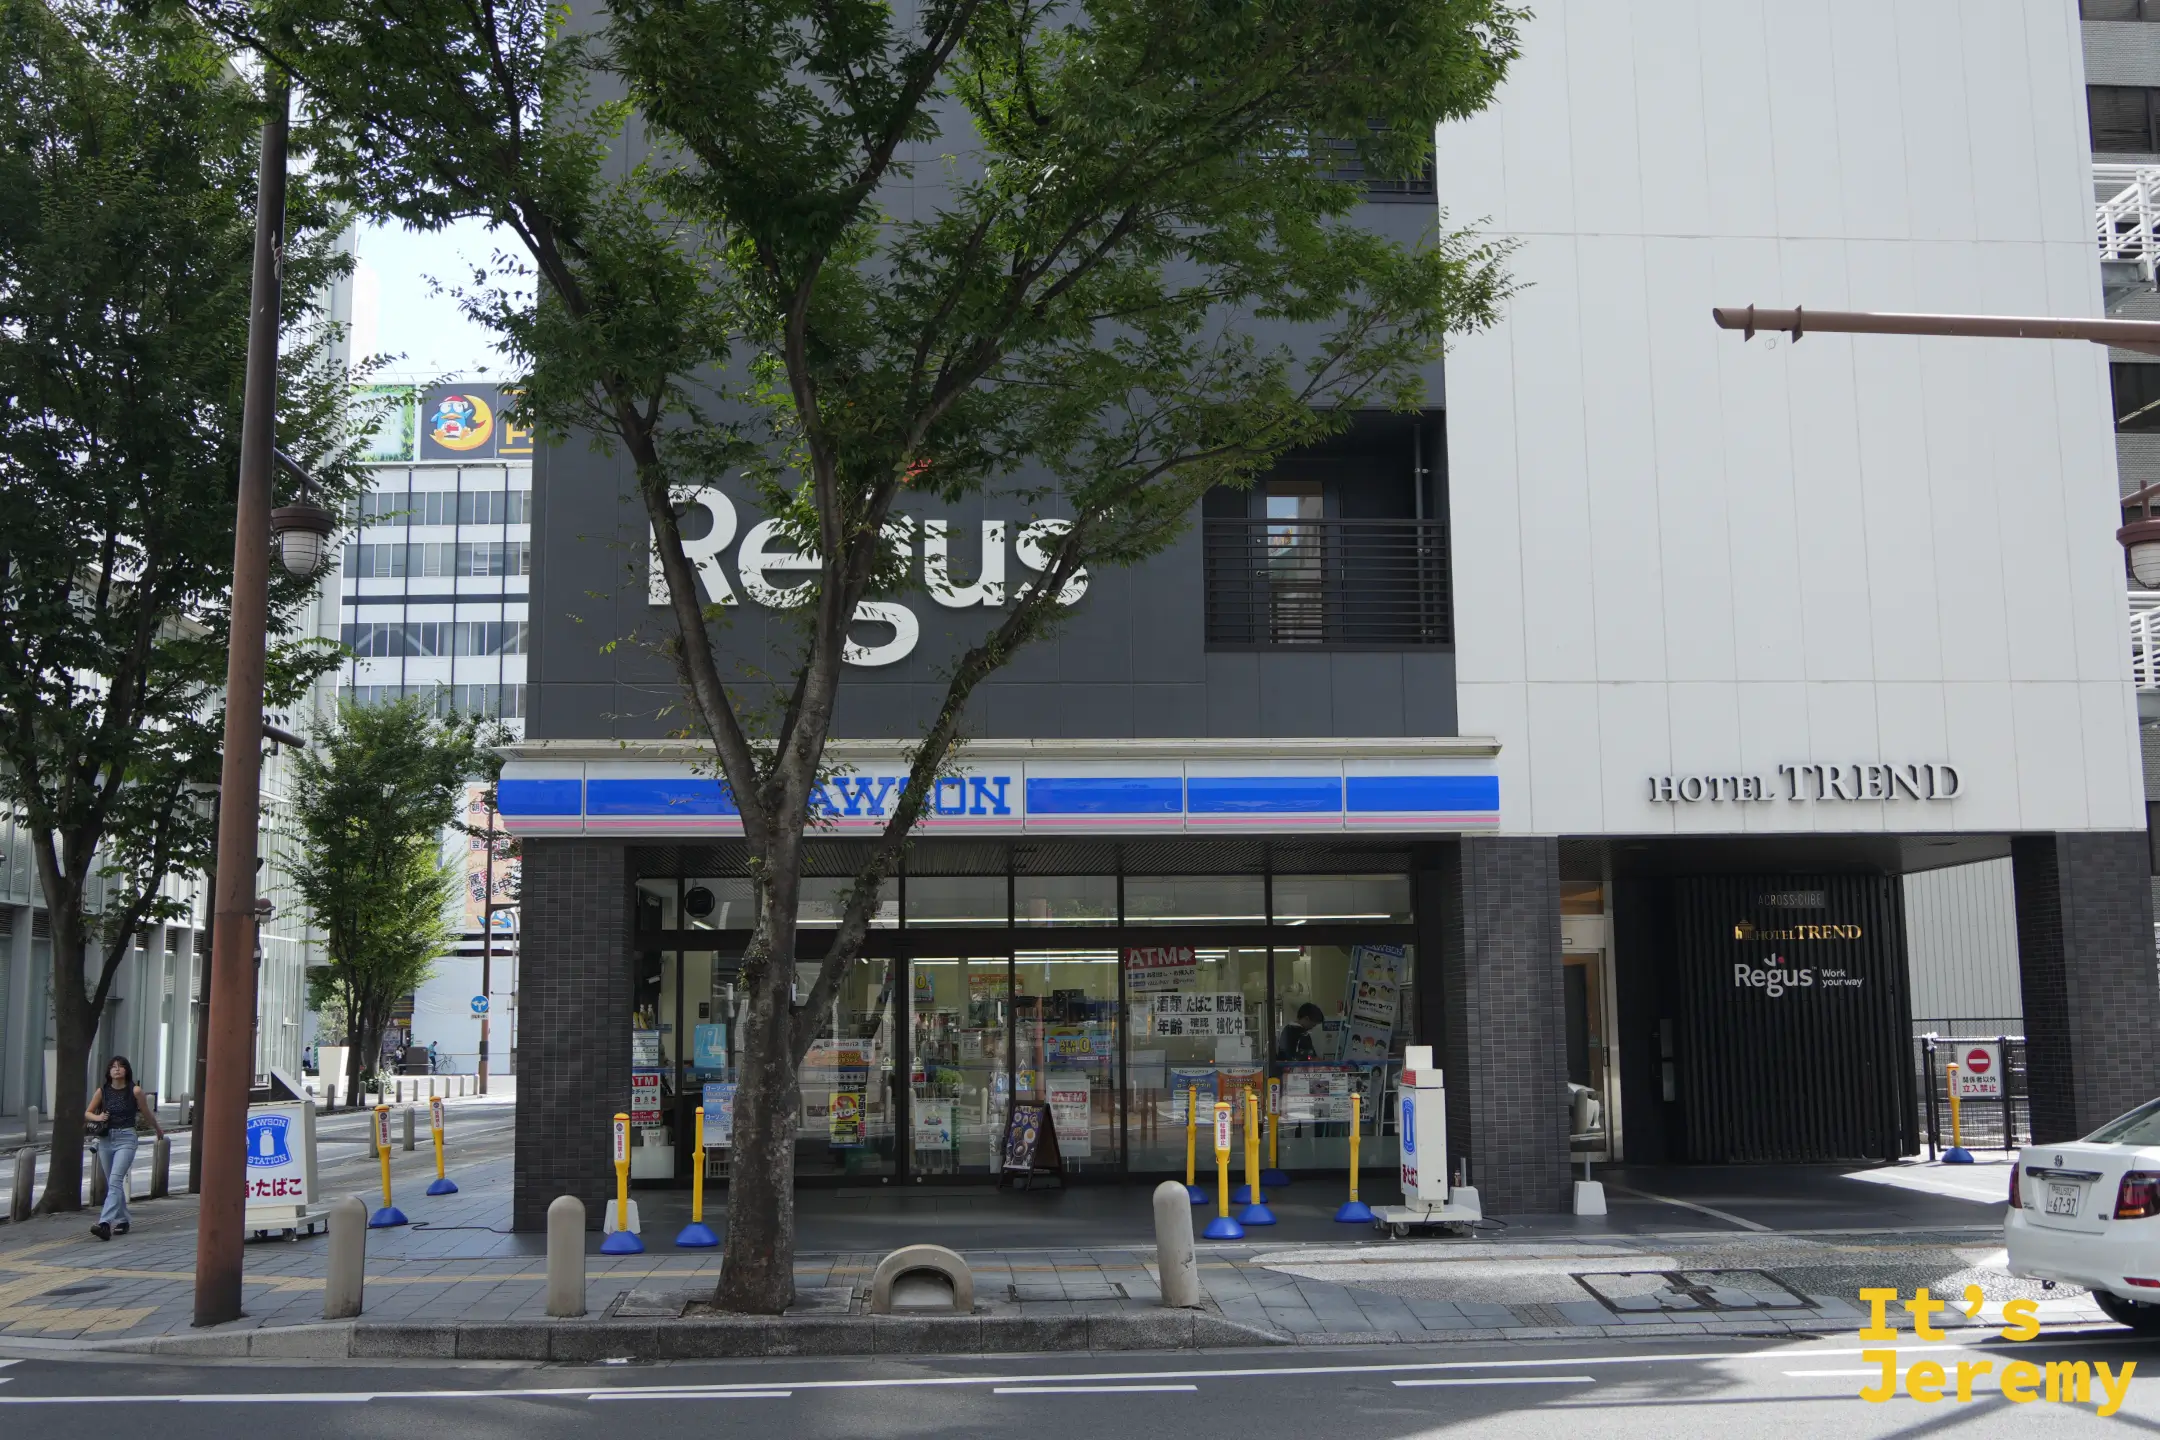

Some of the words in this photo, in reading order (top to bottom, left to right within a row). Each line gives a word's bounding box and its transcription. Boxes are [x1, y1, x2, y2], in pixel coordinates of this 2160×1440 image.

[1649, 775, 1776, 803] HOTEL
[1778, 763, 1966, 802] TREND
[1795, 924, 1862, 940] TREND
[1127, 946, 1178, 968] ATM
[1734, 963, 1813, 998] Regus
[1821, 968, 1846, 978] Work
[1821, 978, 1844, 989] your
[1845, 978, 1863, 988] way
[1157, 995, 1182, 1013] 酒類
[1186, 996, 1212, 1013] たばこ
[1216, 995, 1242, 1013] 販売時
[1157, 1017, 1183, 1035] 年齢
[1216, 1016, 1243, 1035] 強化中
[1962, 1084, 1997, 1093] 立入禁止
[831, 1107, 858, 1119] STOP
[247, 1153, 288, 1165] STATION
